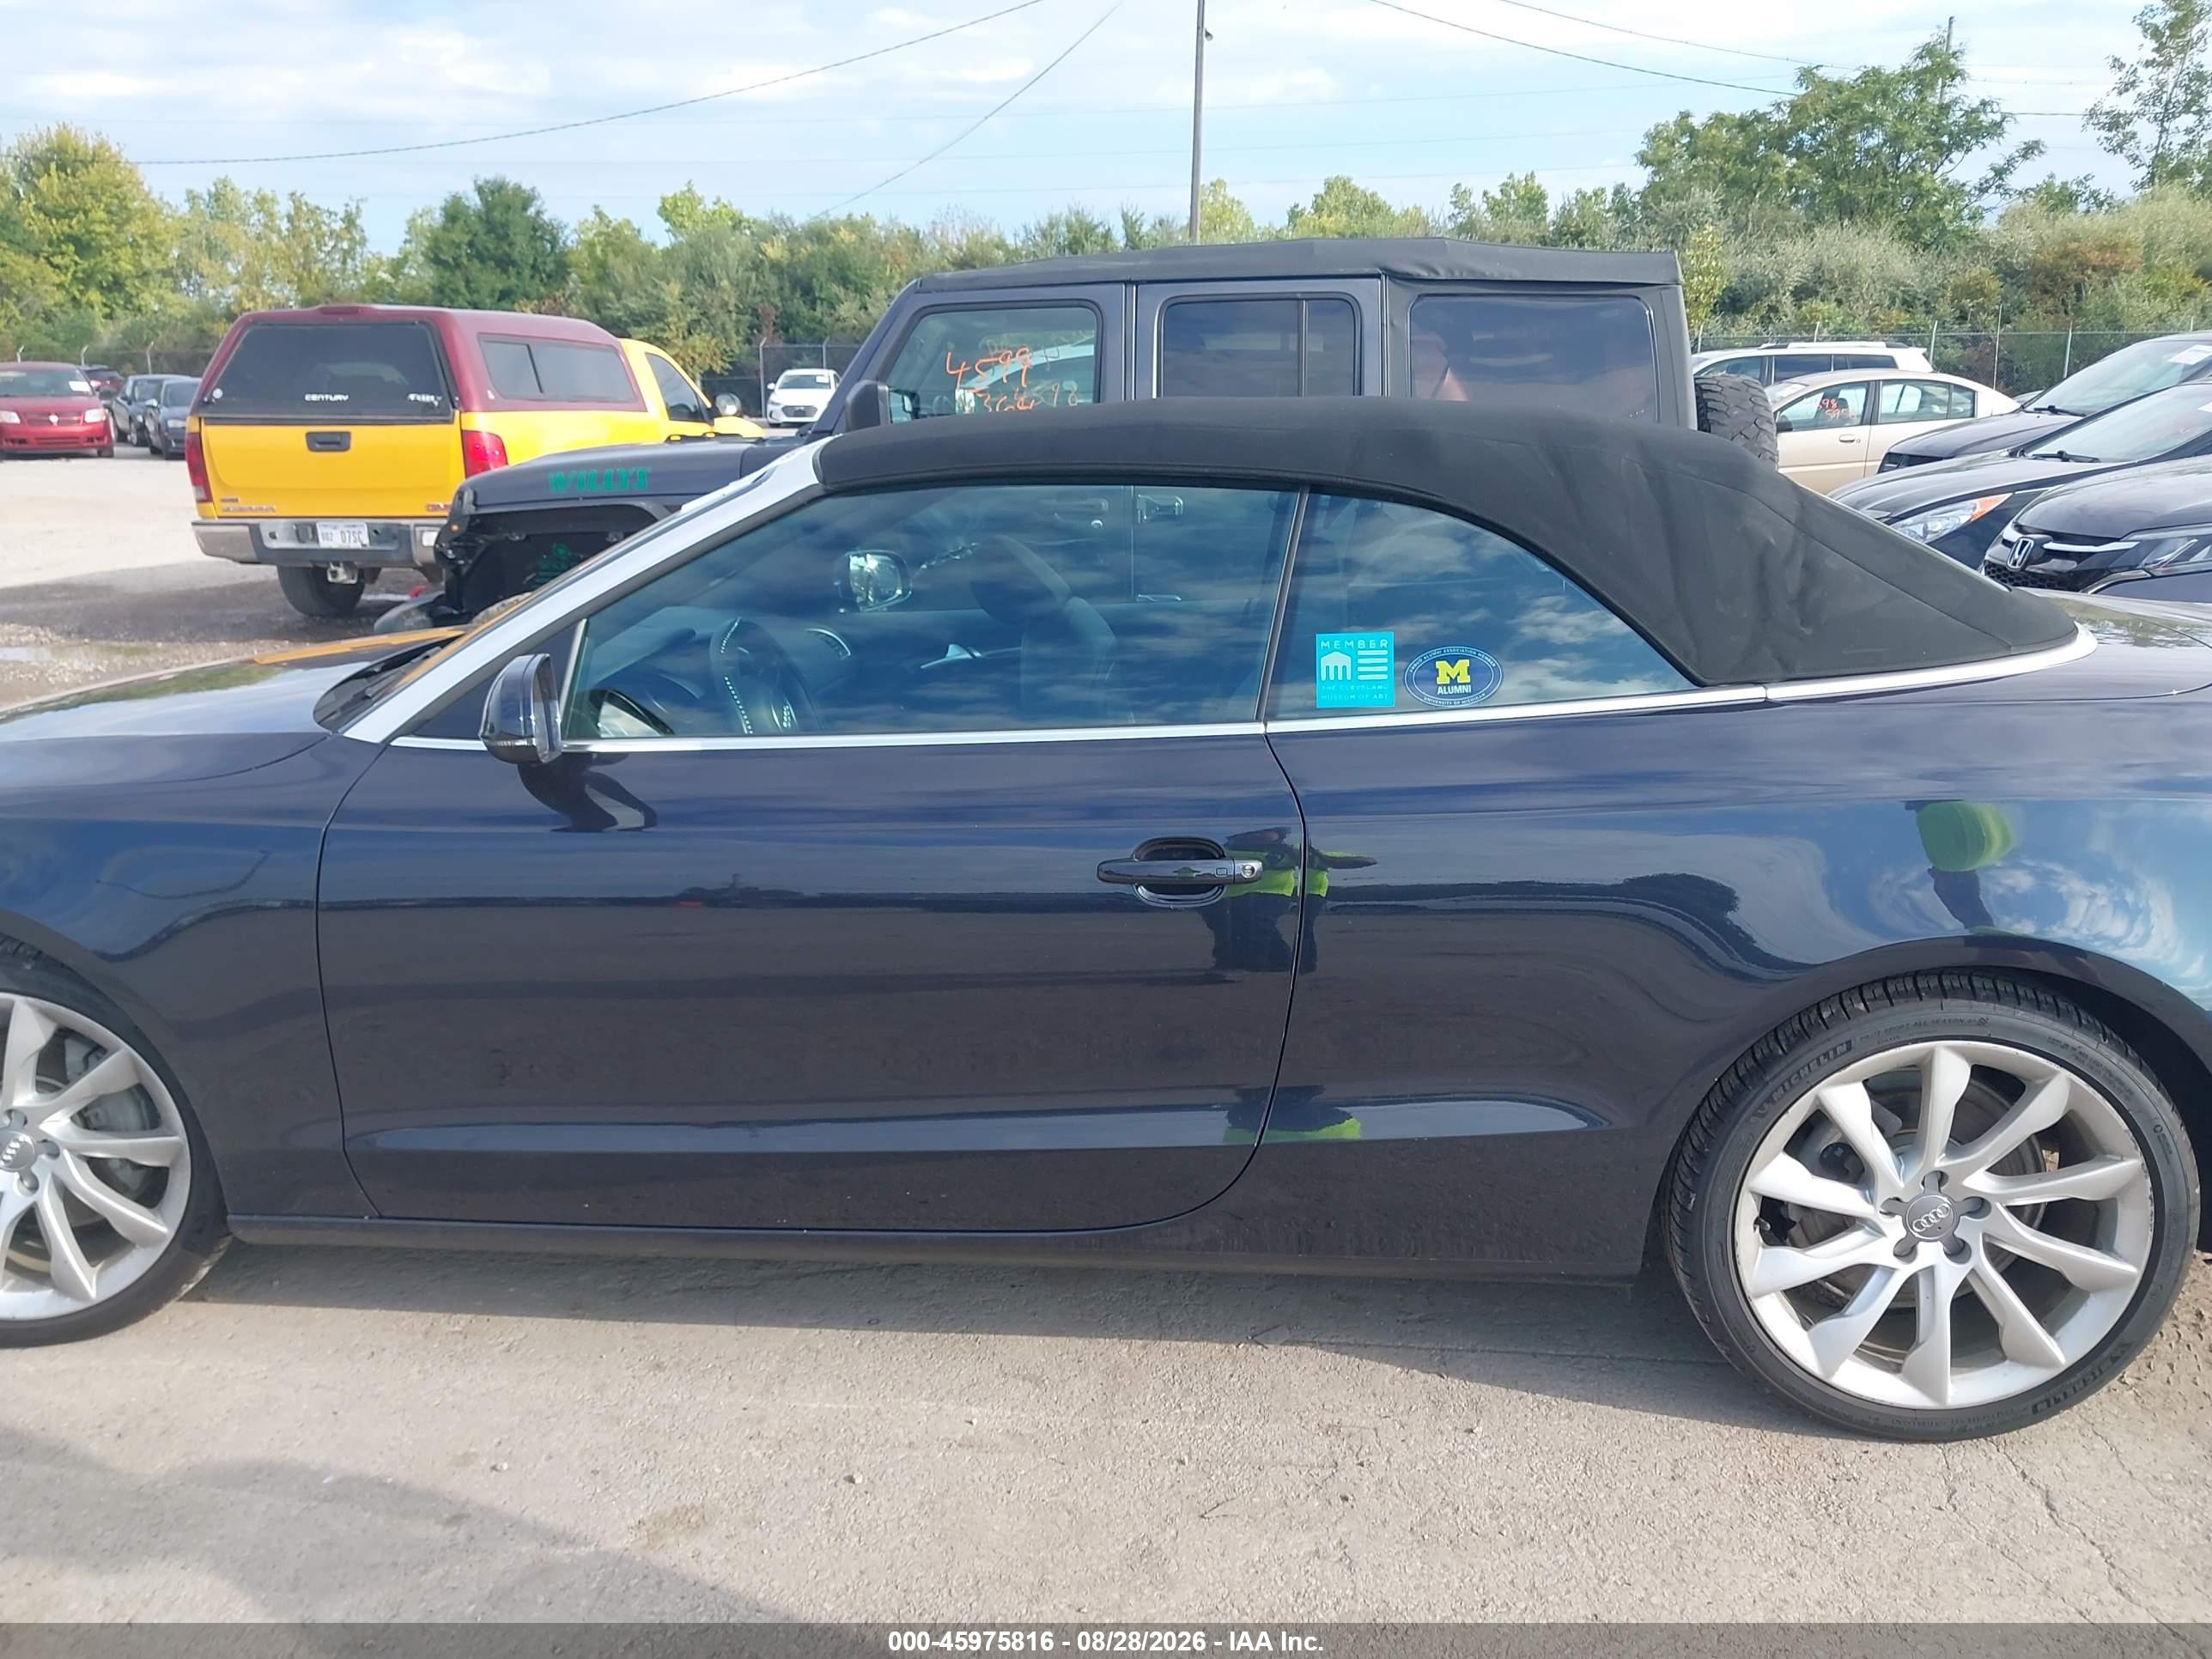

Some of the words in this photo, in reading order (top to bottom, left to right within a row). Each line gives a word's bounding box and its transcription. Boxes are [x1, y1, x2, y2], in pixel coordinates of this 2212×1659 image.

[304, 393, 349, 402] CENTURY
[549, 466, 652, 494] WILLYS
[1320, 639, 1389, 649] MEMBER
[1435, 659, 1470, 685] M
[1437, 684, 1472, 696] ALUMNI
[1771, 1042, 1850, 1102] MICHELIN
